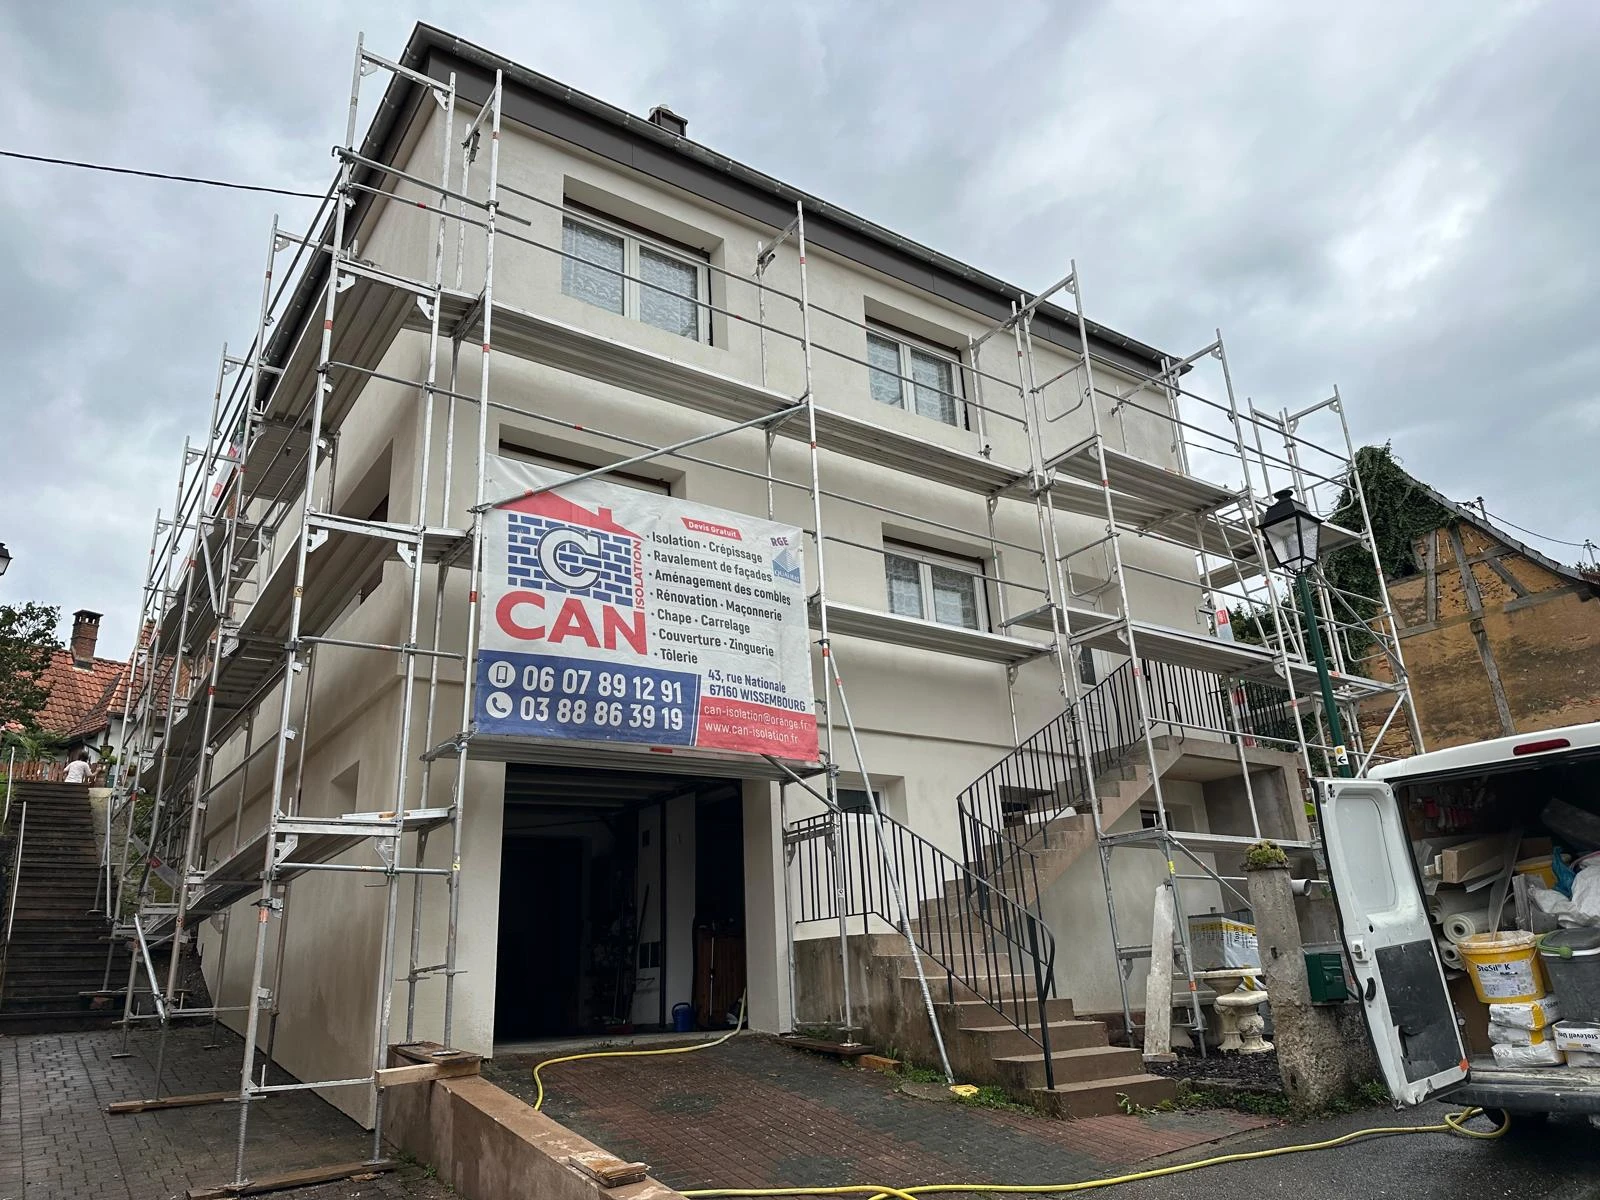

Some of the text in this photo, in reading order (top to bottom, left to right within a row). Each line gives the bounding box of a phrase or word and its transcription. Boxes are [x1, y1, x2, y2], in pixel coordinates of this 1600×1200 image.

[688, 521, 737, 538] Devis Gratuit
[770, 536, 789, 547] RGE
[652, 531, 763, 563] Isolation Crépissage
[632, 540, 645, 610] ISOLATION
[653, 549, 773, 583] Ravalement de façades
[655, 569, 791, 606] Aménagement des combles
[656, 588, 782, 621] Rénovation Maçonnerie
[495, 590, 648, 656] CAN
[657, 608, 750, 635] Chape Carrelage
[659, 628, 774, 657] Couverture Zinguerie
[660, 647, 698, 664] Tôlerie
[522, 665, 682, 704] 06 07 89 12 91
[708, 669, 786, 693] 43, rue Nationale
[710, 684, 806, 712] 67160 WISSEMBOURG
[520, 695, 683, 731] 03 88 86 39 19
[704, 705, 808, 730] can-isolation@orange.fr
[704, 722, 799, 743] www.can-isolation.fr
